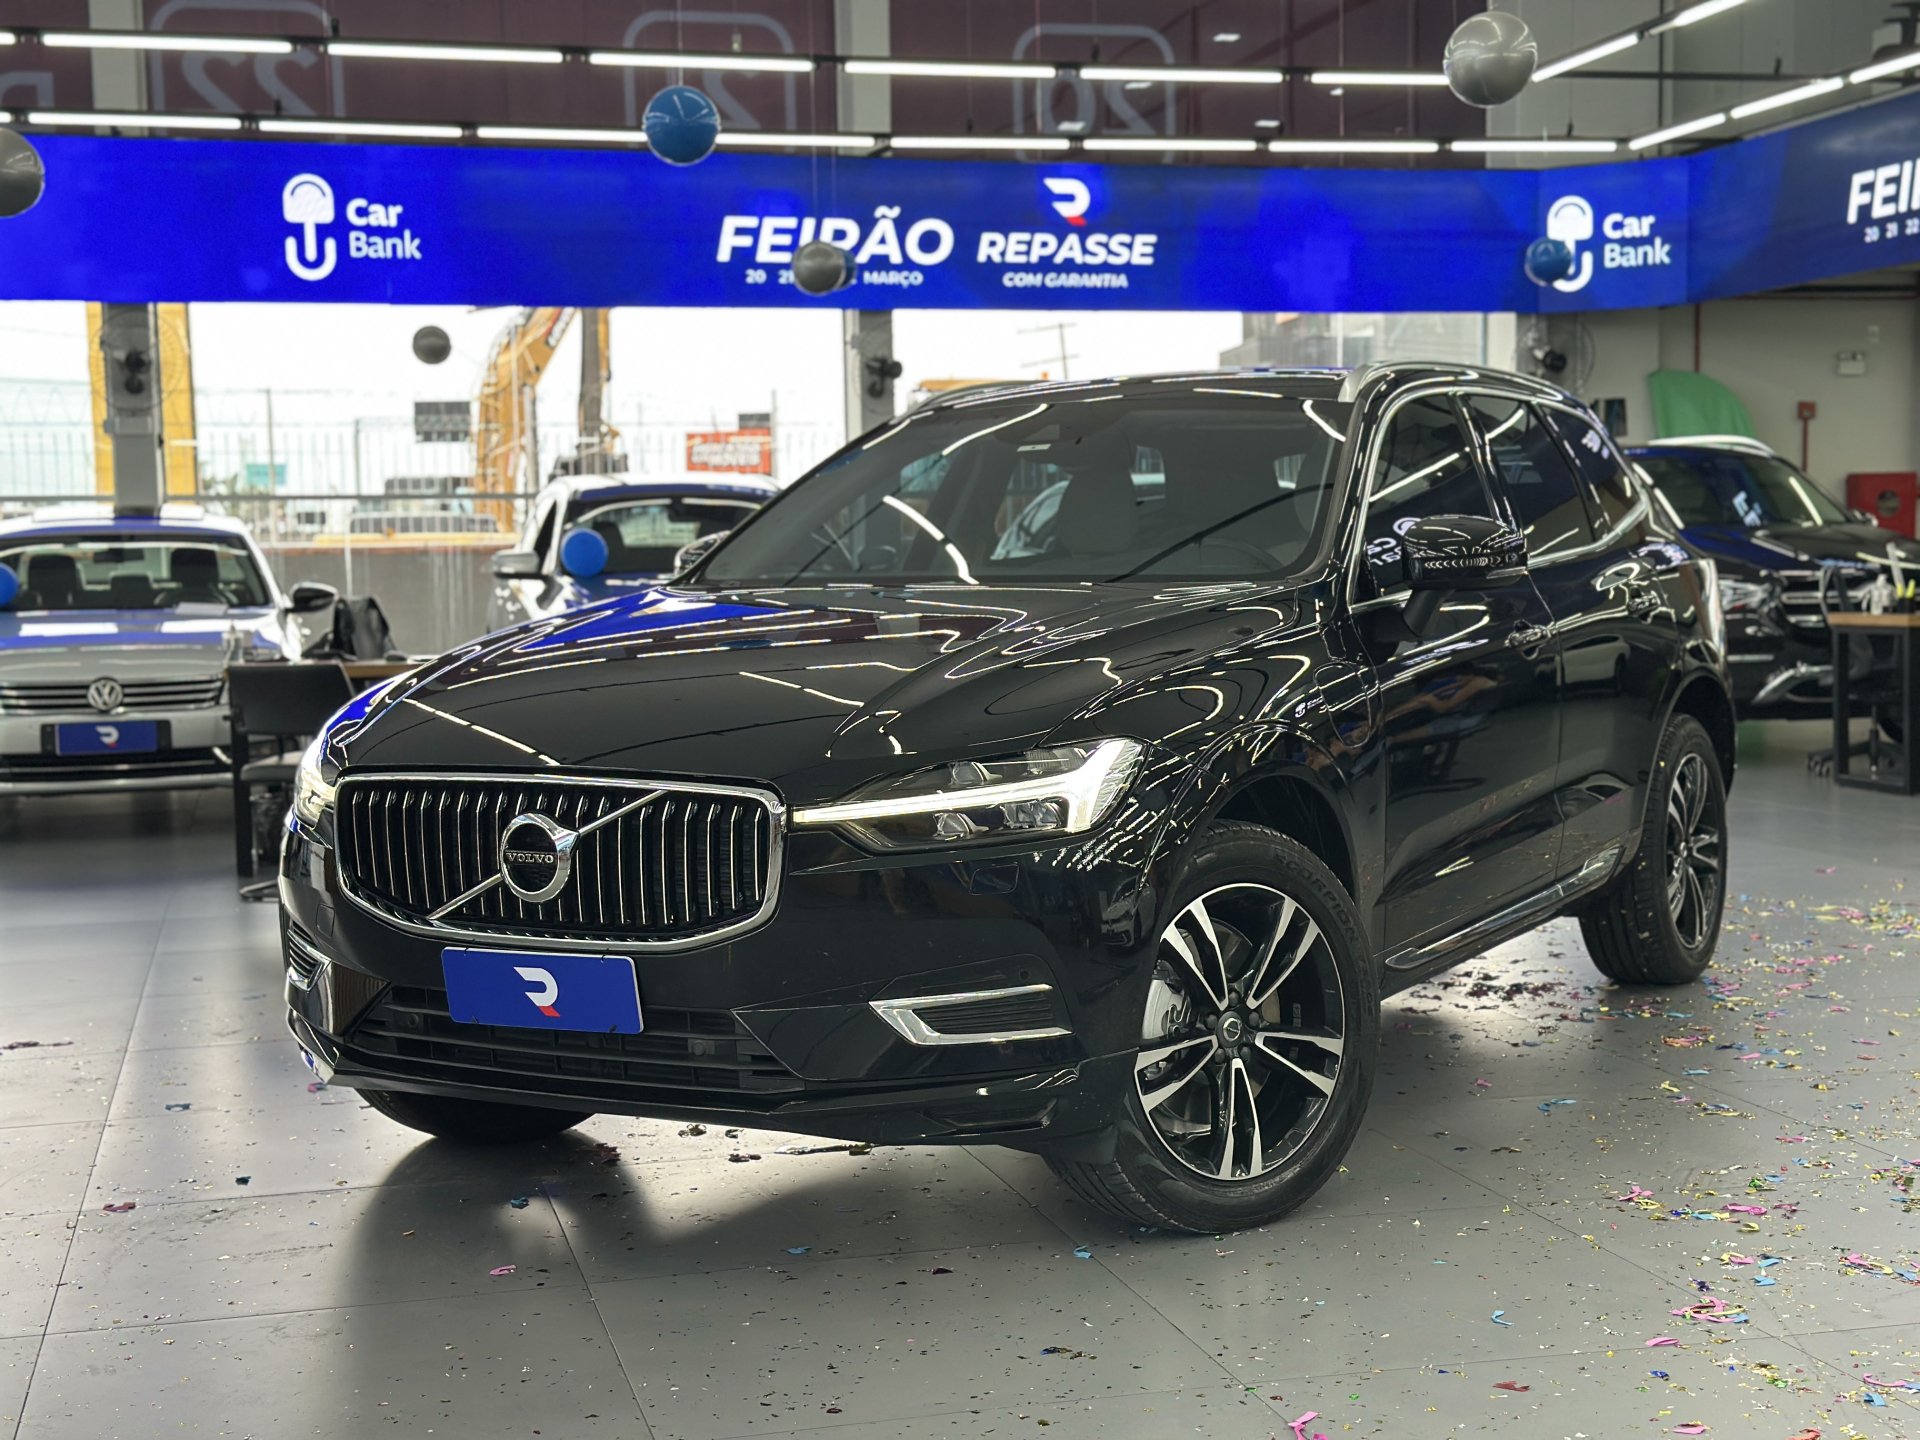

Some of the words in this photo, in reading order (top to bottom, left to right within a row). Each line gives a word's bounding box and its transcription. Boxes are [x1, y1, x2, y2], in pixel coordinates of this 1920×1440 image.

[1846, 157, 1920, 225] FEI
[346, 198, 403, 227] Car
[1602, 212, 1656, 239] Car
[348, 228, 422, 260] Bank
[976, 232, 1158, 265] REPASSE
[1603, 236, 1671, 269] Bank
[745, 268, 767, 285] 20
[863, 270, 924, 288] MARÇO
[1002, 271, 1043, 288] COM
[1043, 272, 1129, 289] GARANTIA
[506, 852, 554, 864] VOLVO
